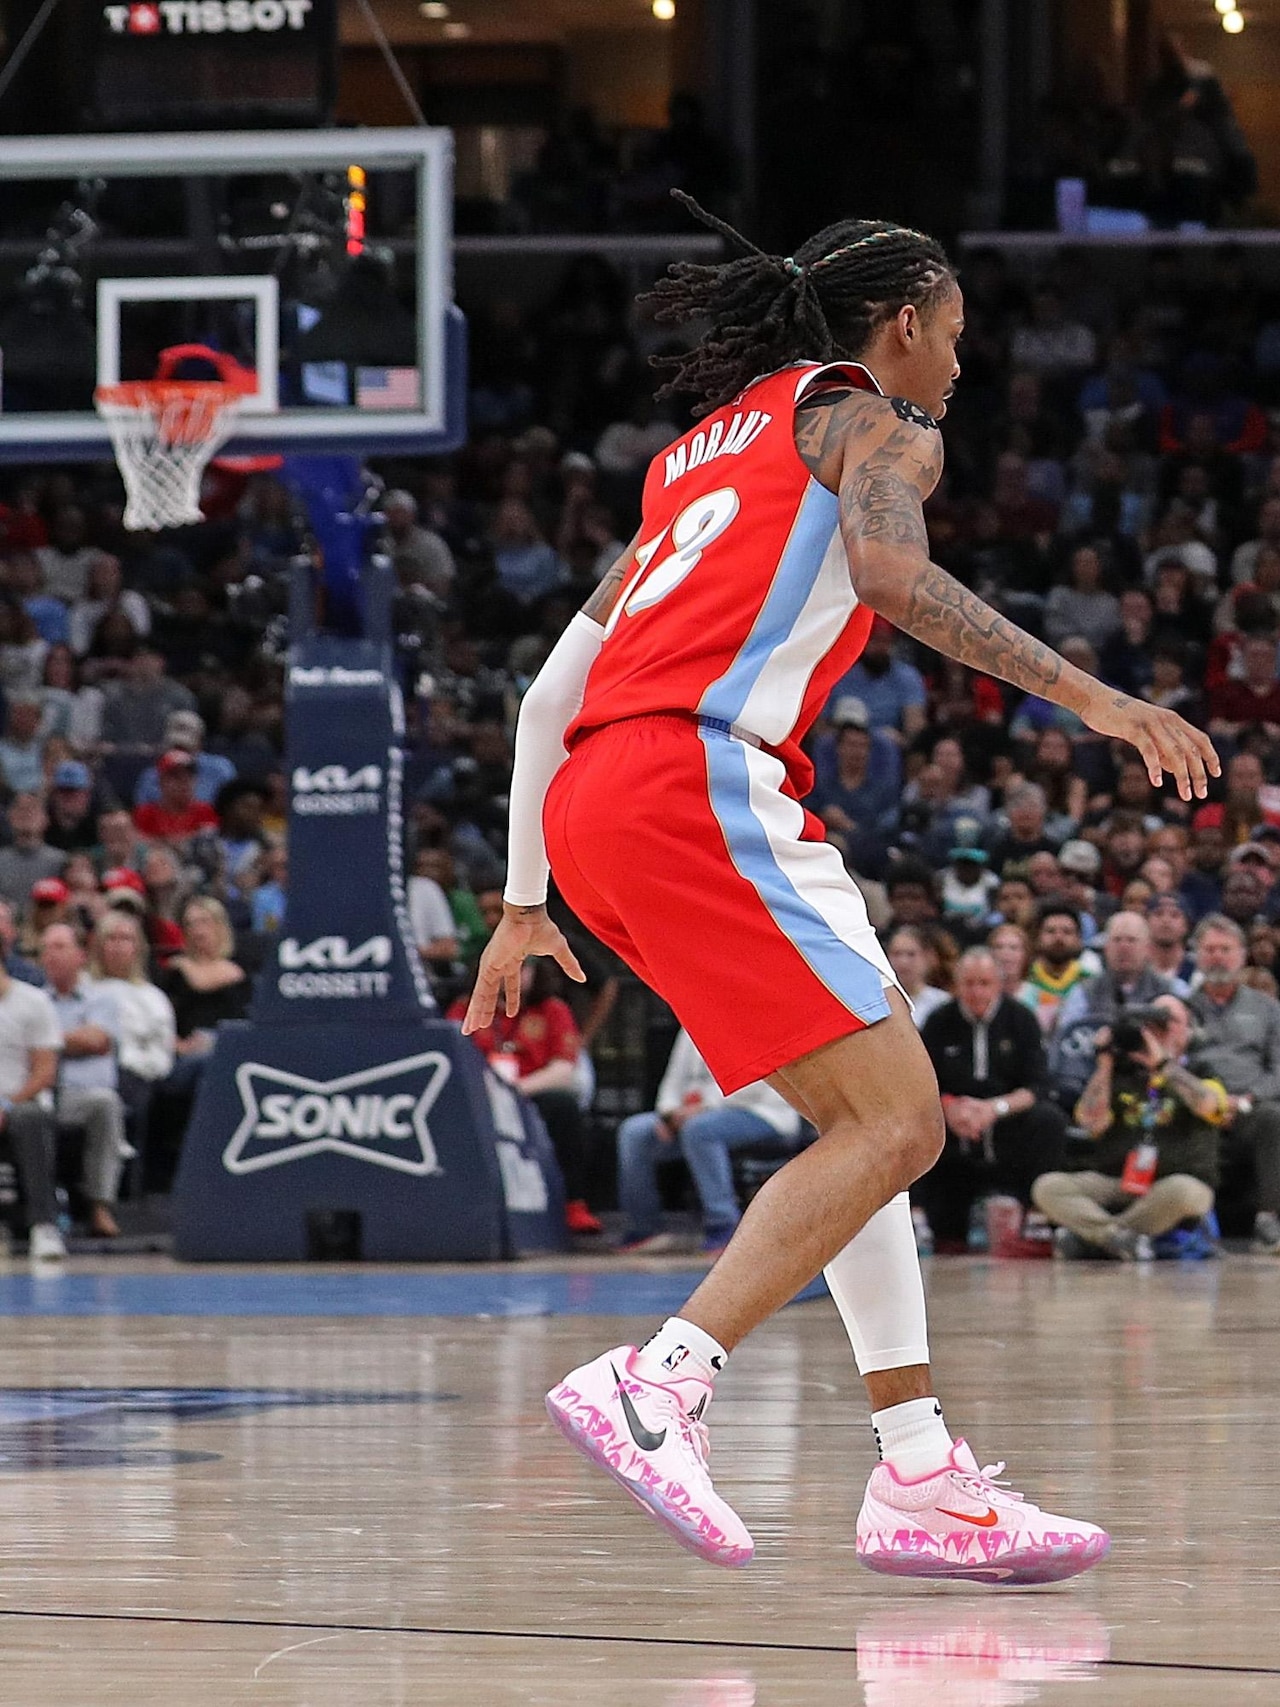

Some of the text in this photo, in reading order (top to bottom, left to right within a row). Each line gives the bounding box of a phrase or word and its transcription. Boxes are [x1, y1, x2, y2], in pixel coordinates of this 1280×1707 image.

[160, 0, 313, 34] TISSOT
[663, 410, 773, 488] MORANT
[254, 1093, 417, 1140] SONIC
